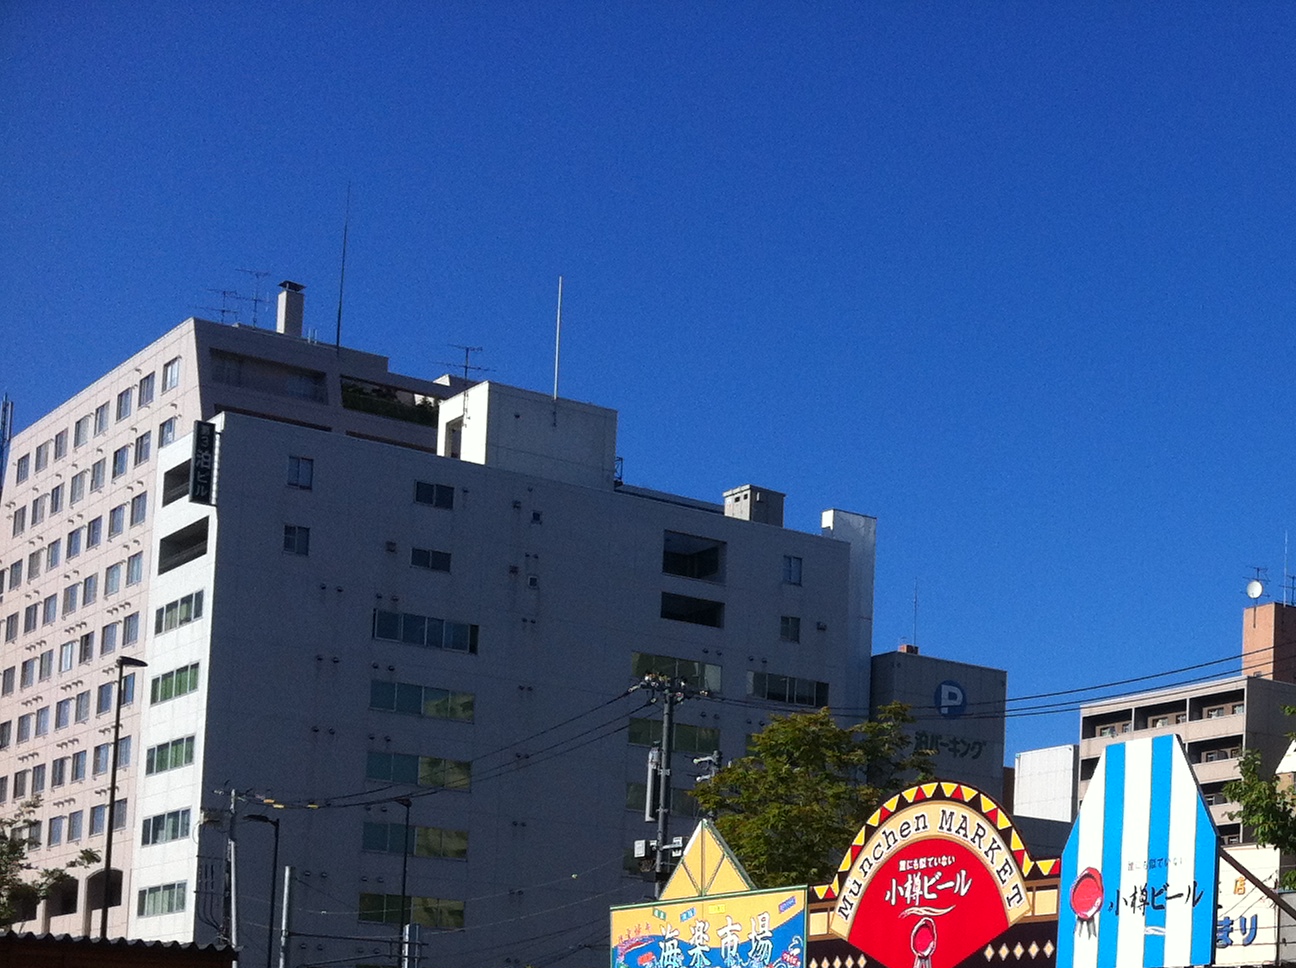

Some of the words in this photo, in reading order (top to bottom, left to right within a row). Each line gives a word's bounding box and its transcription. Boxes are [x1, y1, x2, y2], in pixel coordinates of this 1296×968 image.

[938, 809, 1025, 909] MARKET
[884, 869, 973, 906] 小樽ビール
[1107, 880, 1204, 916] 小樽ビール
